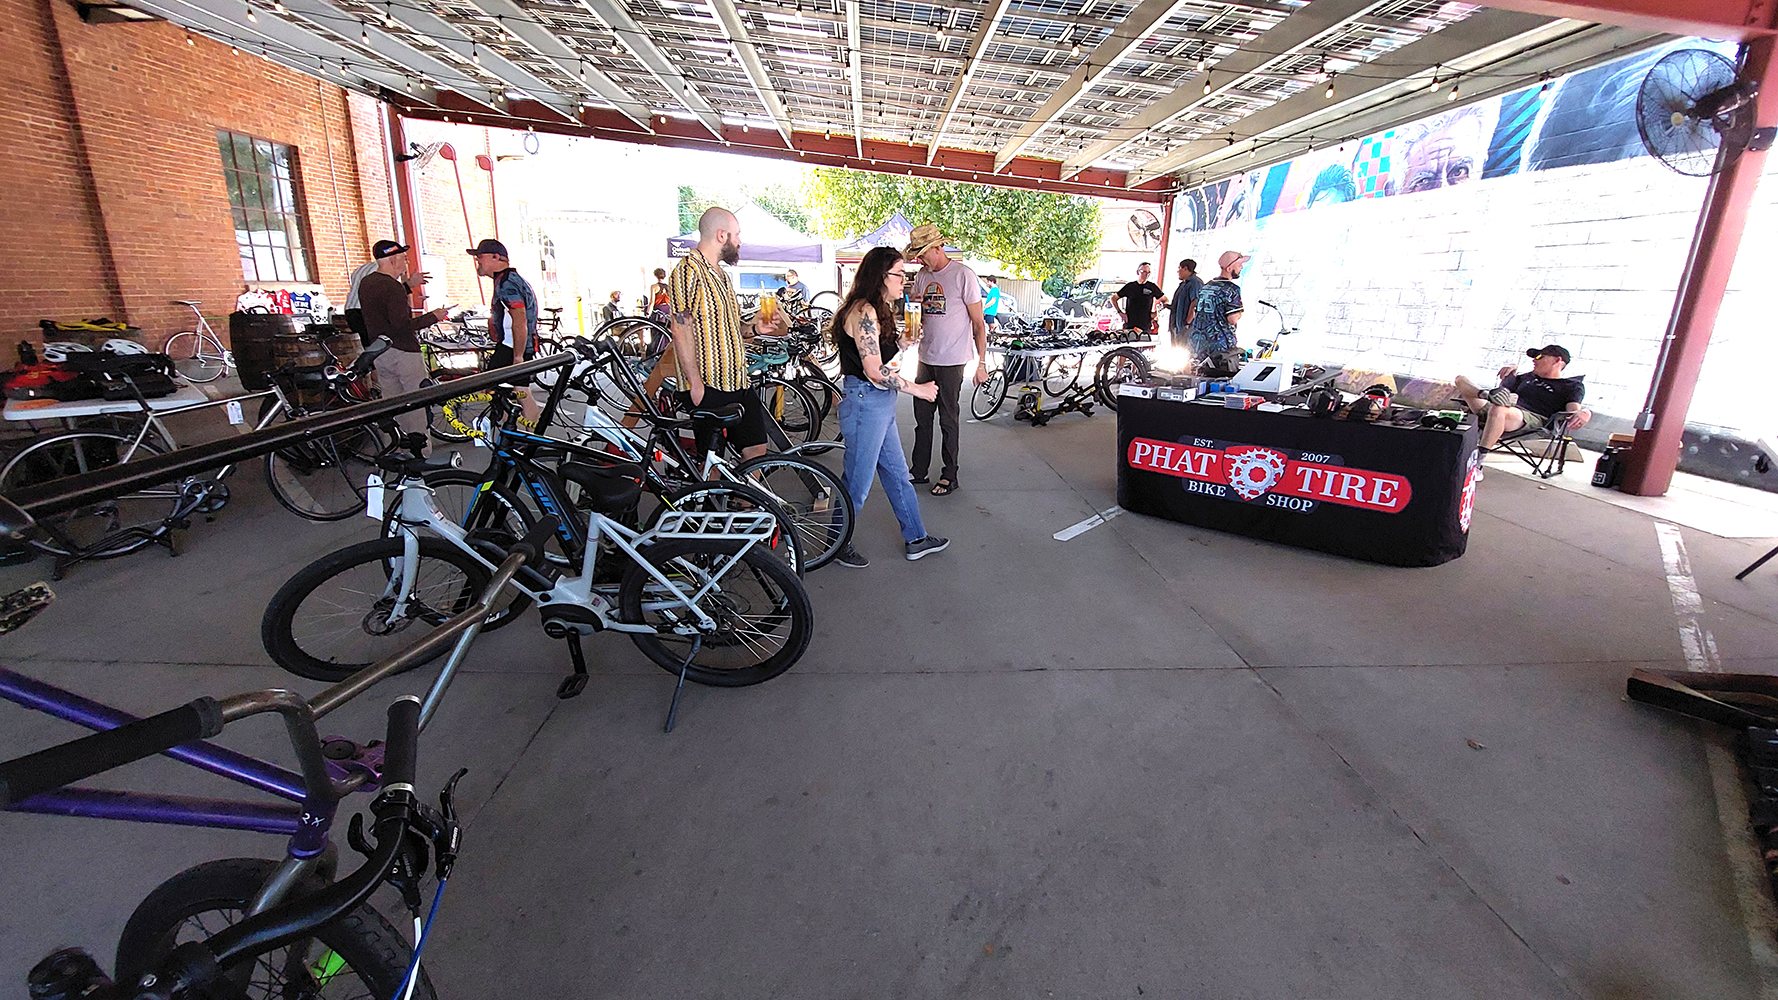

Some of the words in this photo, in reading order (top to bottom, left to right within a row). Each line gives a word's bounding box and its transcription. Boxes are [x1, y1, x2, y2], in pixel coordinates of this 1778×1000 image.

[1193, 438, 1214, 449] EST.
[1301, 452, 1330, 464] 2007
[1133, 442, 1217, 476] PHAT
[1296, 466, 1399, 507] TIRE
[1188, 480, 1226, 497] BIKE
[1266, 494, 1313, 512] SHOP
